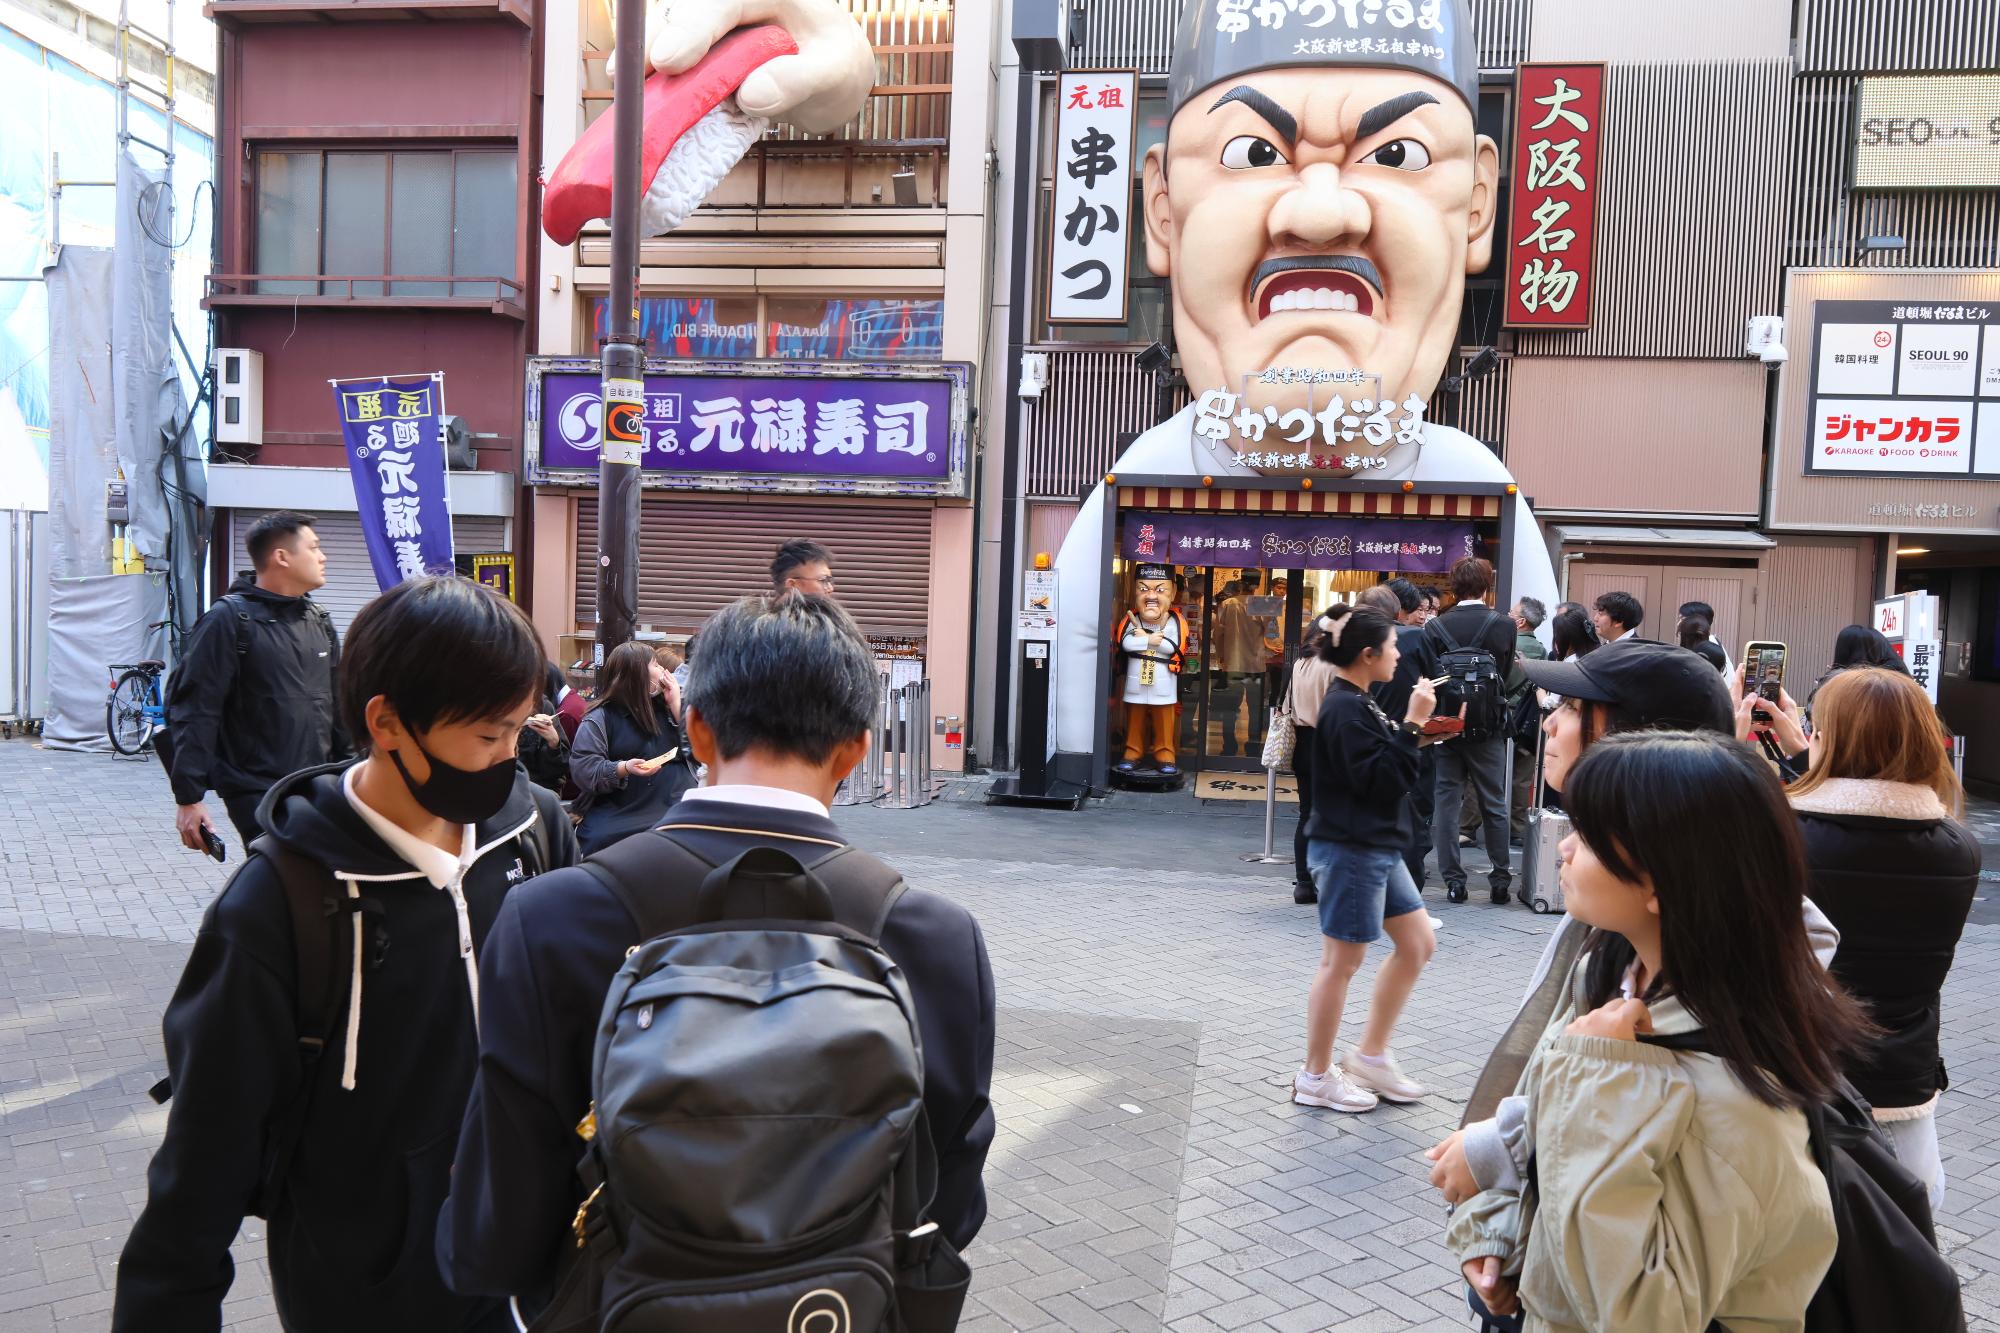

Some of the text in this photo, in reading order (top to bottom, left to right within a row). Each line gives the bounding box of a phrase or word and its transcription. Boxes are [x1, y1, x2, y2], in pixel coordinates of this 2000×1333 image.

[1293, 37, 1445, 59] 大阪新世界元祖串かつ
[1067, 84, 1124, 109] 元祖
[1518, 78, 1590, 314] 大阪名物
[1061, 126, 1119, 301] 串かつ
[1834, 354, 1880, 365] 韓国料理
[1909, 350, 1969, 362] SEOUL 90
[1258, 367, 1366, 386] 創業昭和四年
[1195, 385, 1428, 450] 串かつだるま
[1825, 414, 1961, 443] ジャンカラ
[1230, 452, 1388, 470] 大阪新世界元祖串かつ
[1834, 448, 1875, 456] KARAOKE
[1890, 449, 1915, 457] FOOD
[1135, 524, 1156, 556] 元祖
[1178, 535, 1252, 551] 創業昭和四年
[1881, 607, 1897, 633] 24h
